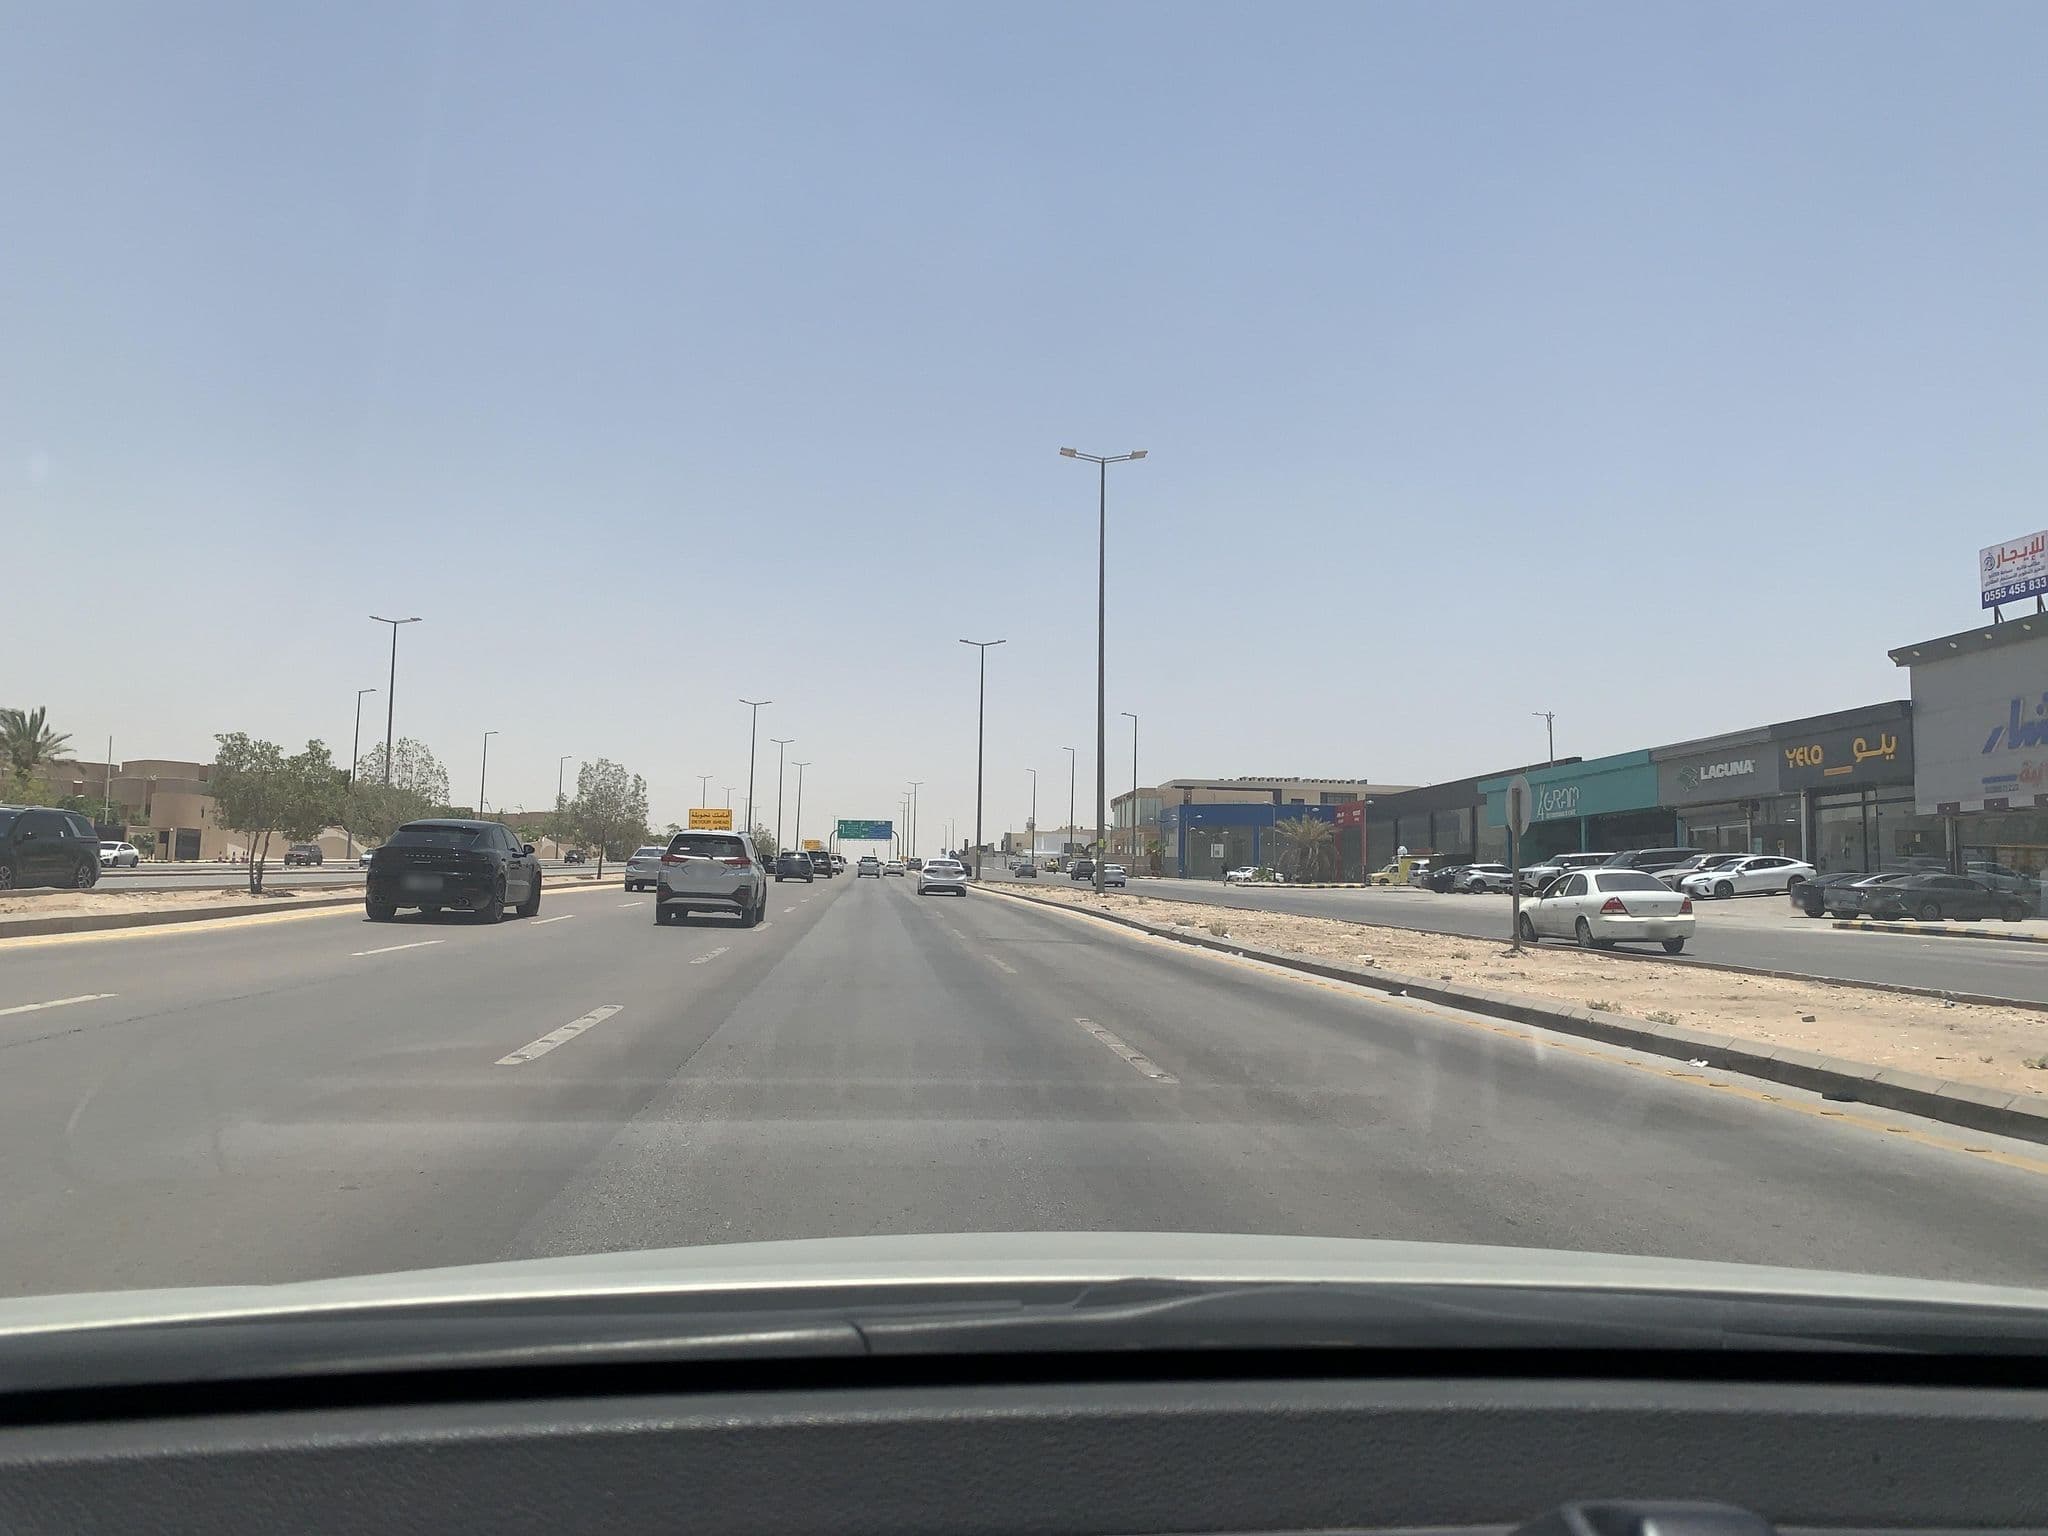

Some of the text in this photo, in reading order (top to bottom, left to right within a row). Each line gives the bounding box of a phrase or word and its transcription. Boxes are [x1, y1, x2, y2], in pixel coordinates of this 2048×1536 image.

[1984, 587, 2007, 602] 0555
[2008, 582, 2026, 596] 455
[2028, 576, 2048, 591] 833
[1784, 744, 1824, 769] YELO
[1852, 733, 1897, 763] يلو
[1700, 759, 1755, 780] LACUNA
